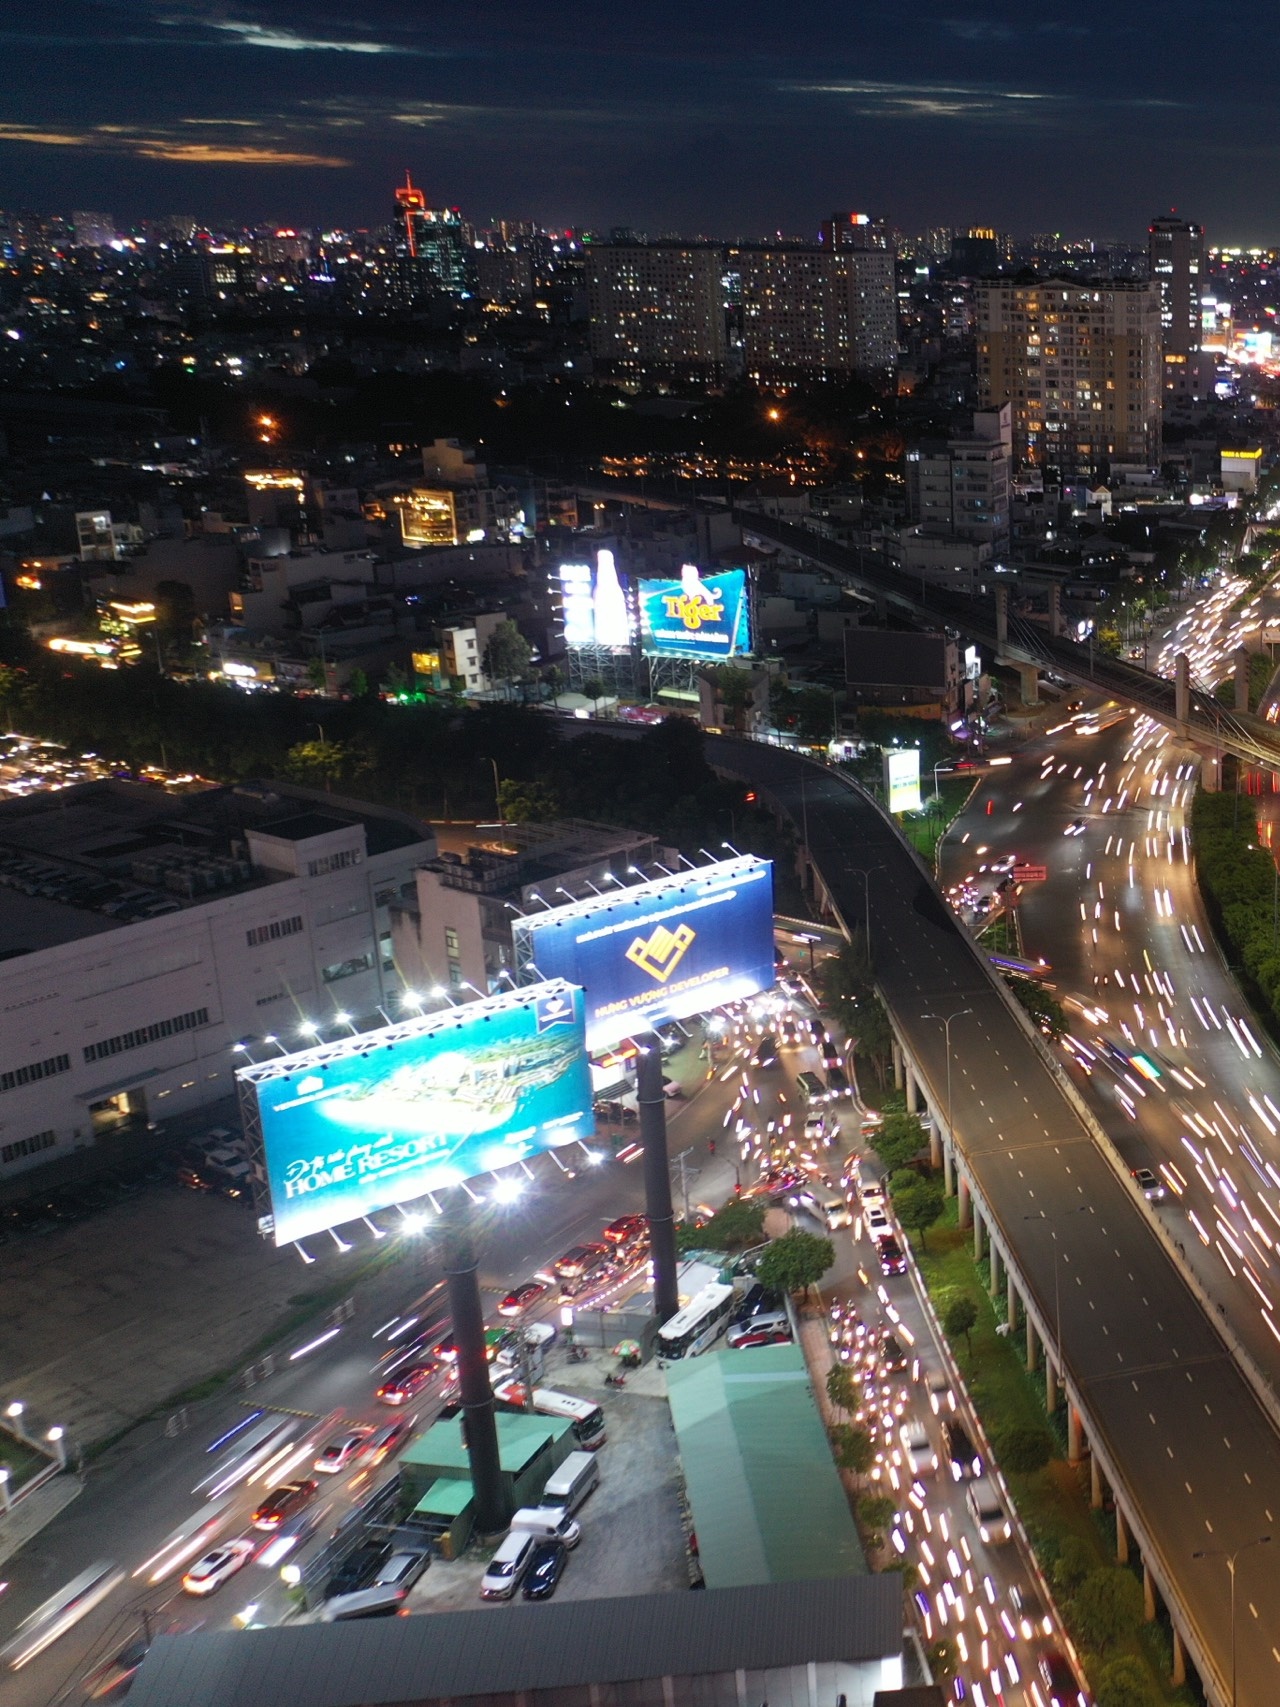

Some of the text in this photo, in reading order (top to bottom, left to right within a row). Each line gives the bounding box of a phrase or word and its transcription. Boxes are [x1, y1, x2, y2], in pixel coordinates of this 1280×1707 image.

[663, 595, 724, 629] Tiger
[669, 967, 730, 993] DEVELOPER
[283, 1162, 358, 1199] HOME
[357, 1133, 449, 1175] RESORT
